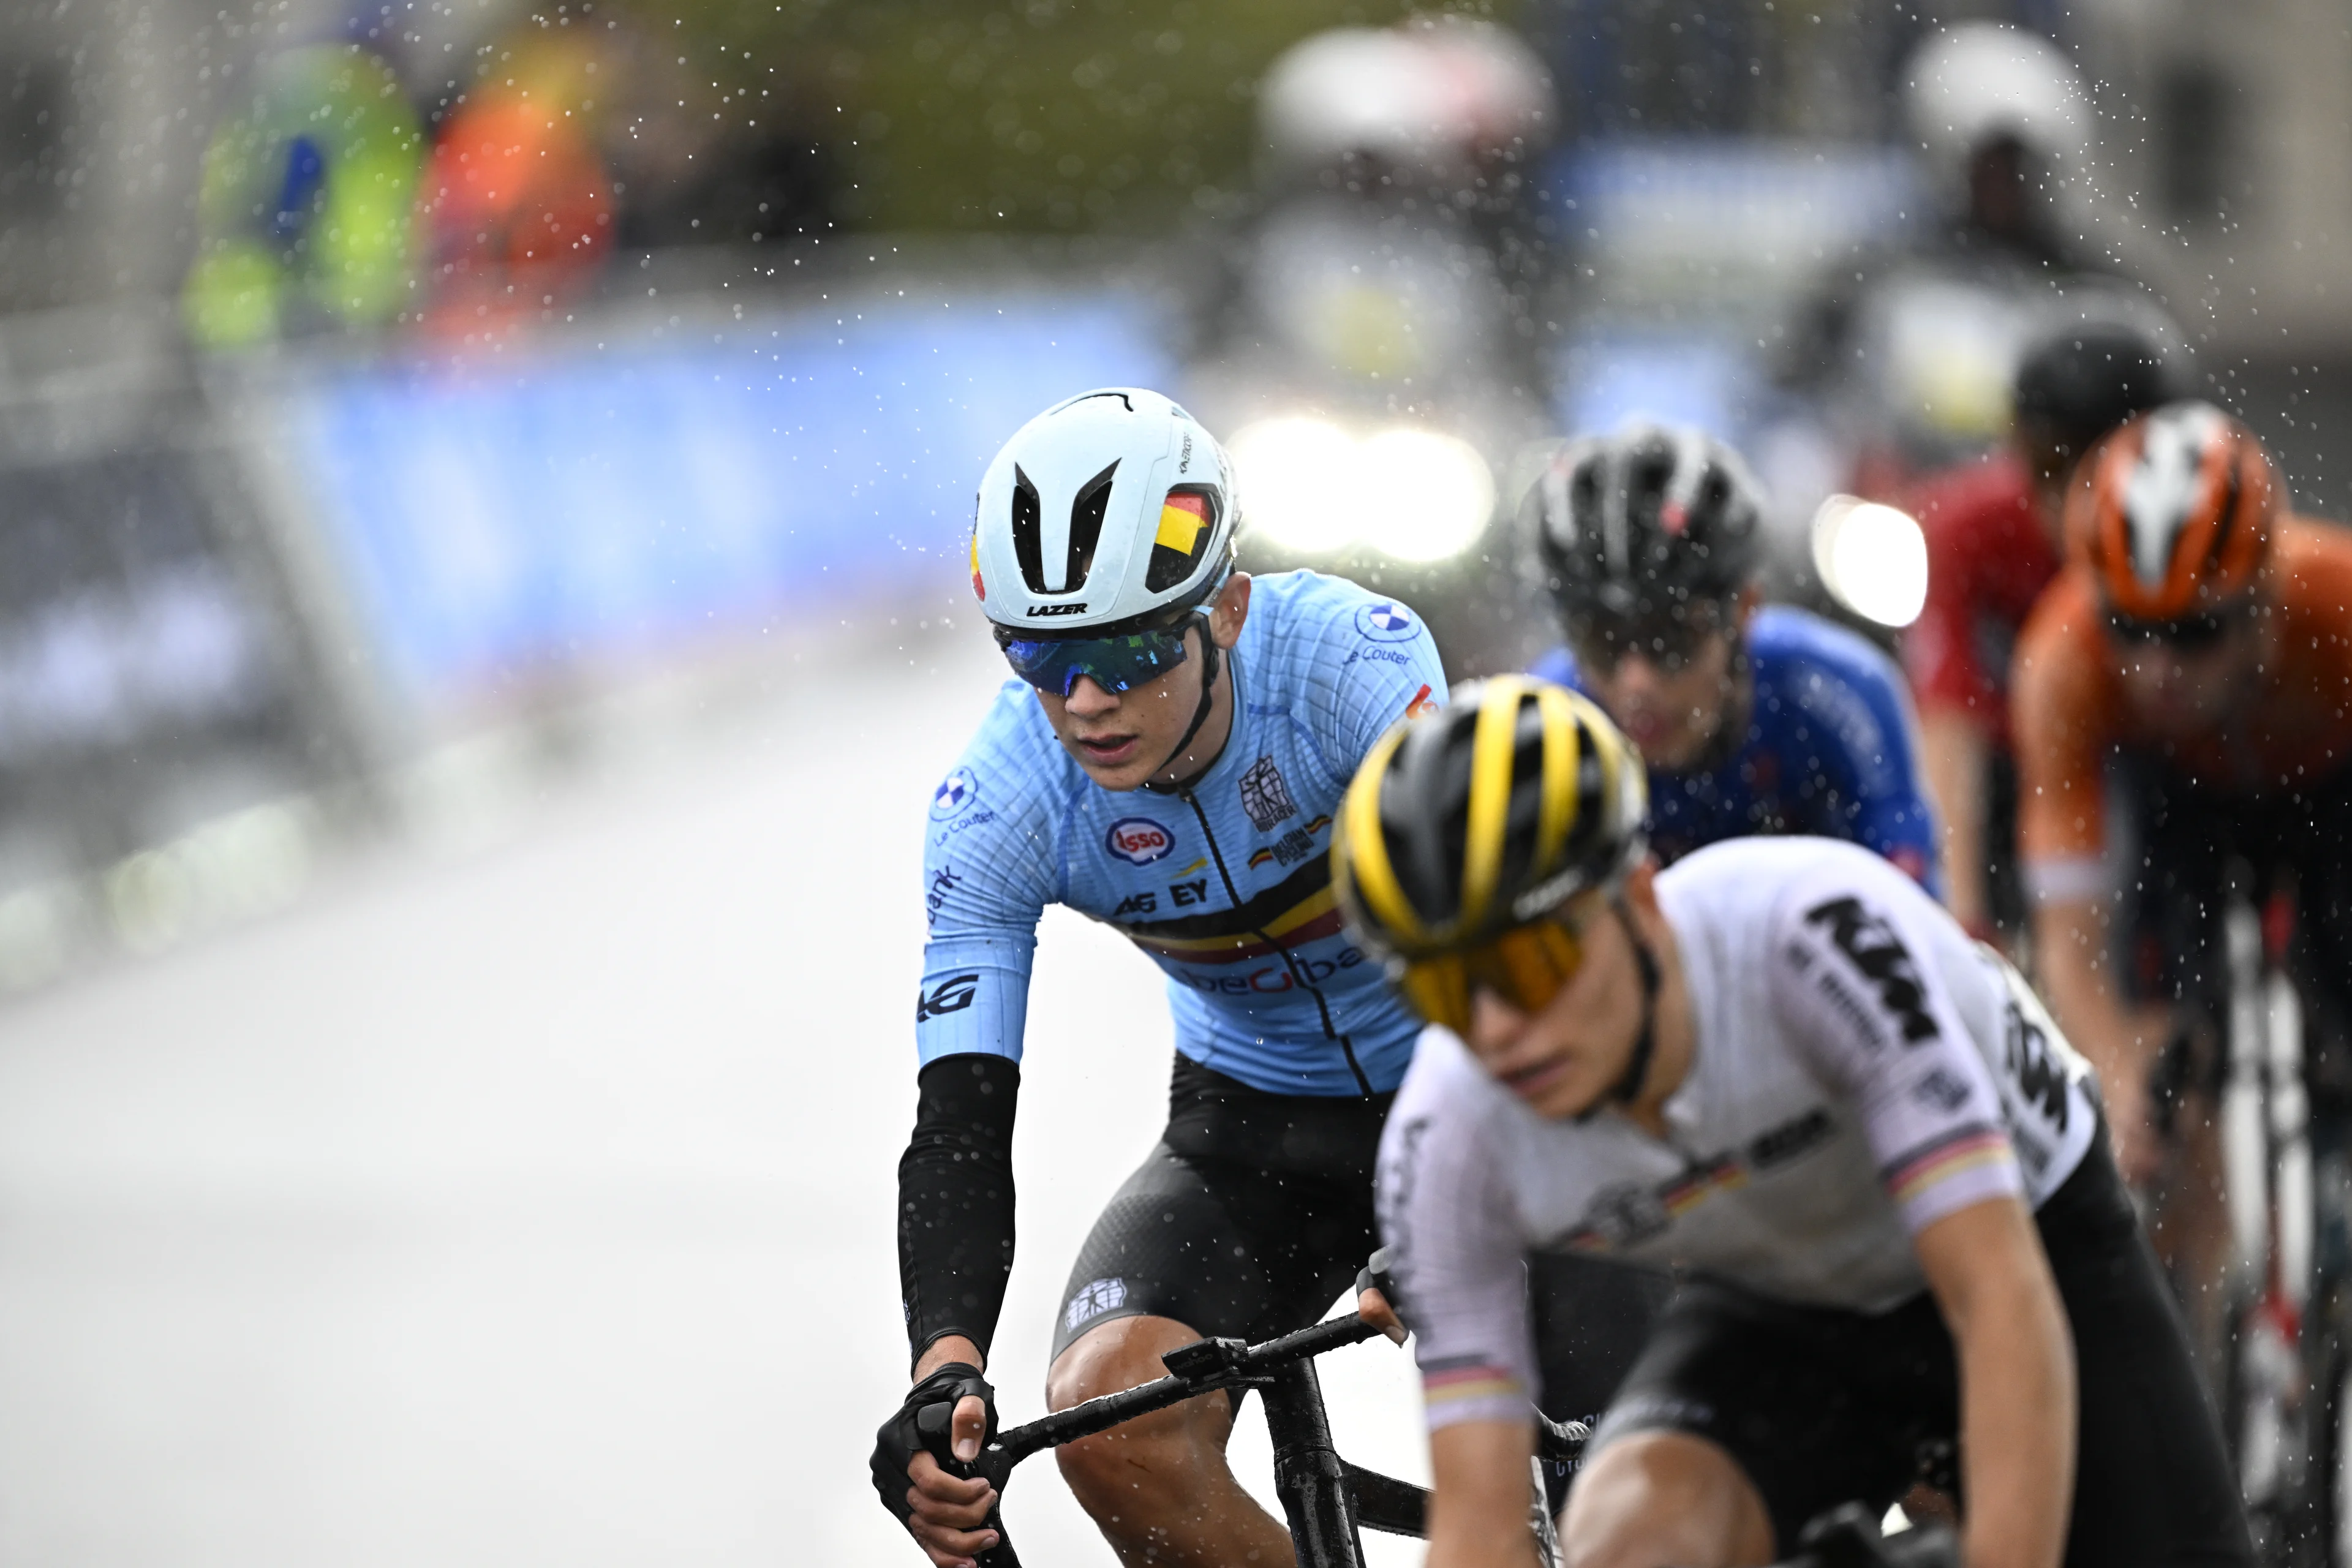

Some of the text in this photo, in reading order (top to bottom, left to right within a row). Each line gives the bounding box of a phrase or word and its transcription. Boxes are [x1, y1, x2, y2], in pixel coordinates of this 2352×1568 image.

[1026, 603, 1088, 617] LAZER
[1362, 645, 1411, 666] Couter
[933, 811, 995, 847] Le Couter
[1169, 878, 1207, 908] EY
[1179, 946, 1368, 996] beoba
[1172, 1353, 1213, 1370] wahoo
